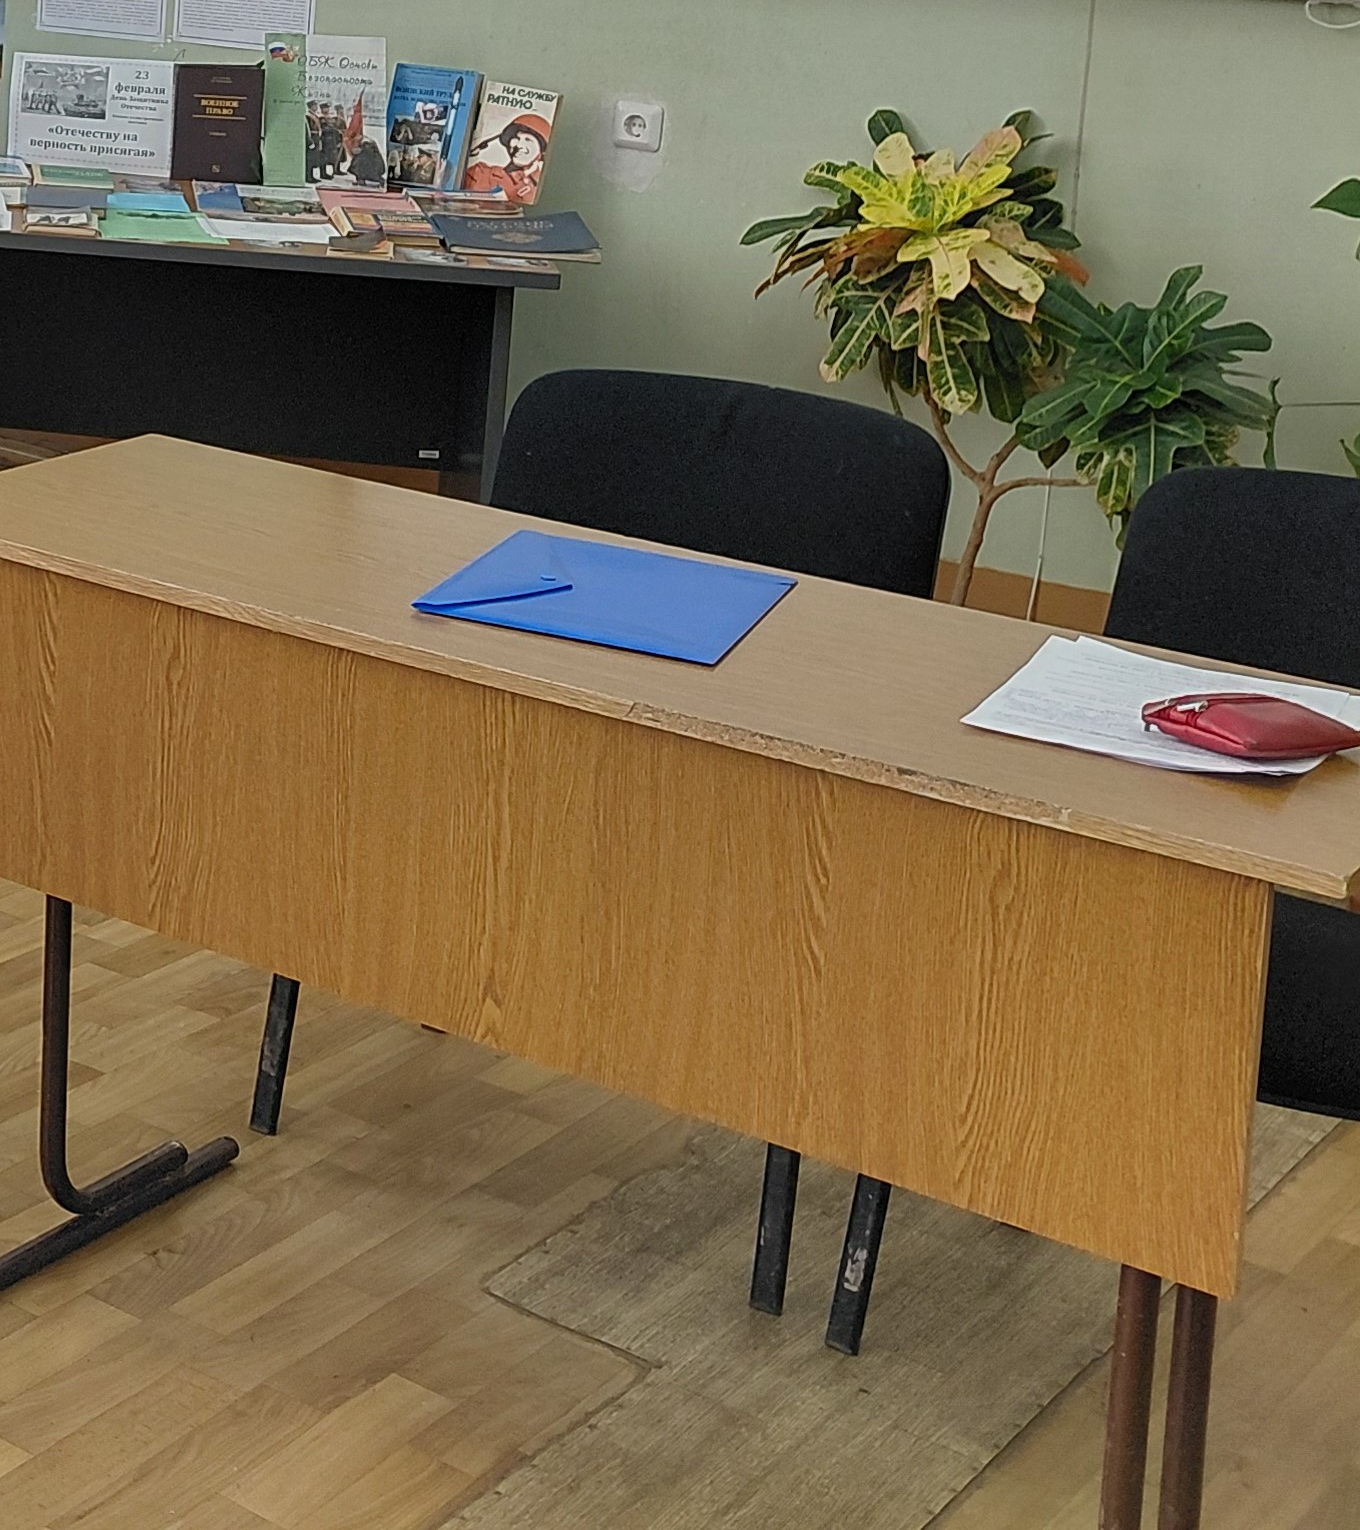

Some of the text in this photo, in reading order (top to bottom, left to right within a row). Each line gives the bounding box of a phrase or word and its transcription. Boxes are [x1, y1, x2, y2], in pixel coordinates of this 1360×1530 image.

[134, 70, 149, 80] 23
[114, 81, 166, 96] февраля
[502, 85, 557, 102] НА СЛУЖБУ
[205, 107, 234, 115] ПРАВО
[48, 125, 138, 143] «Отечеству на
[29, 138, 156, 158] верность присягая»
